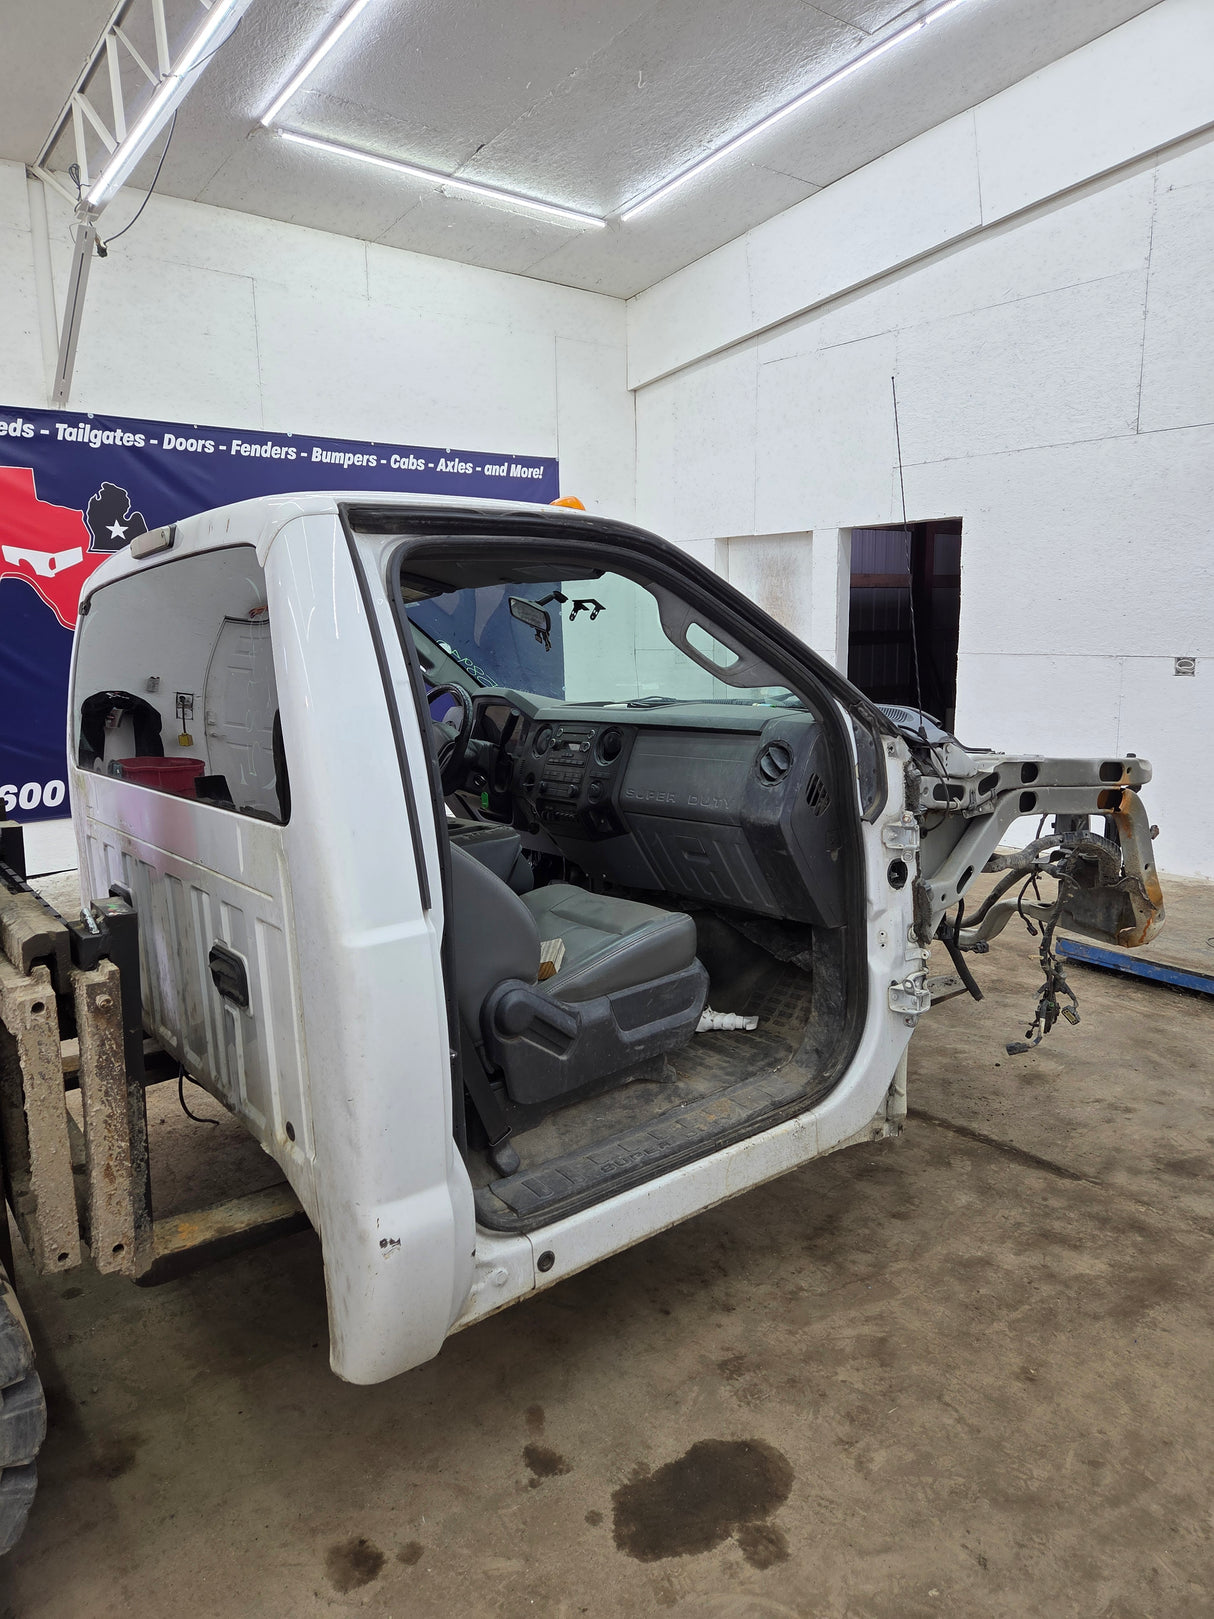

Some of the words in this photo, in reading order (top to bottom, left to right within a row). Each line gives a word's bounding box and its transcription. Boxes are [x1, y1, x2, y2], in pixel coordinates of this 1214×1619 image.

[0, 418, 35, 438] eds
[56, 422, 146, 449] Tailgates
[162, 433, 216, 454] Doors
[230, 439, 297, 460] Fenders
[311, 446, 378, 469] Bumpers
[390, 454, 426, 471] Cabs
[436, 457, 474, 474] Axles
[484, 462, 508, 477] and
[509, 463, 545, 479] More!
[0, 779, 66, 813] 600
[625, 788, 676, 804] SUPER
[687, 794, 730, 811] DUTY
[600, 1140, 674, 1174] SUPER
